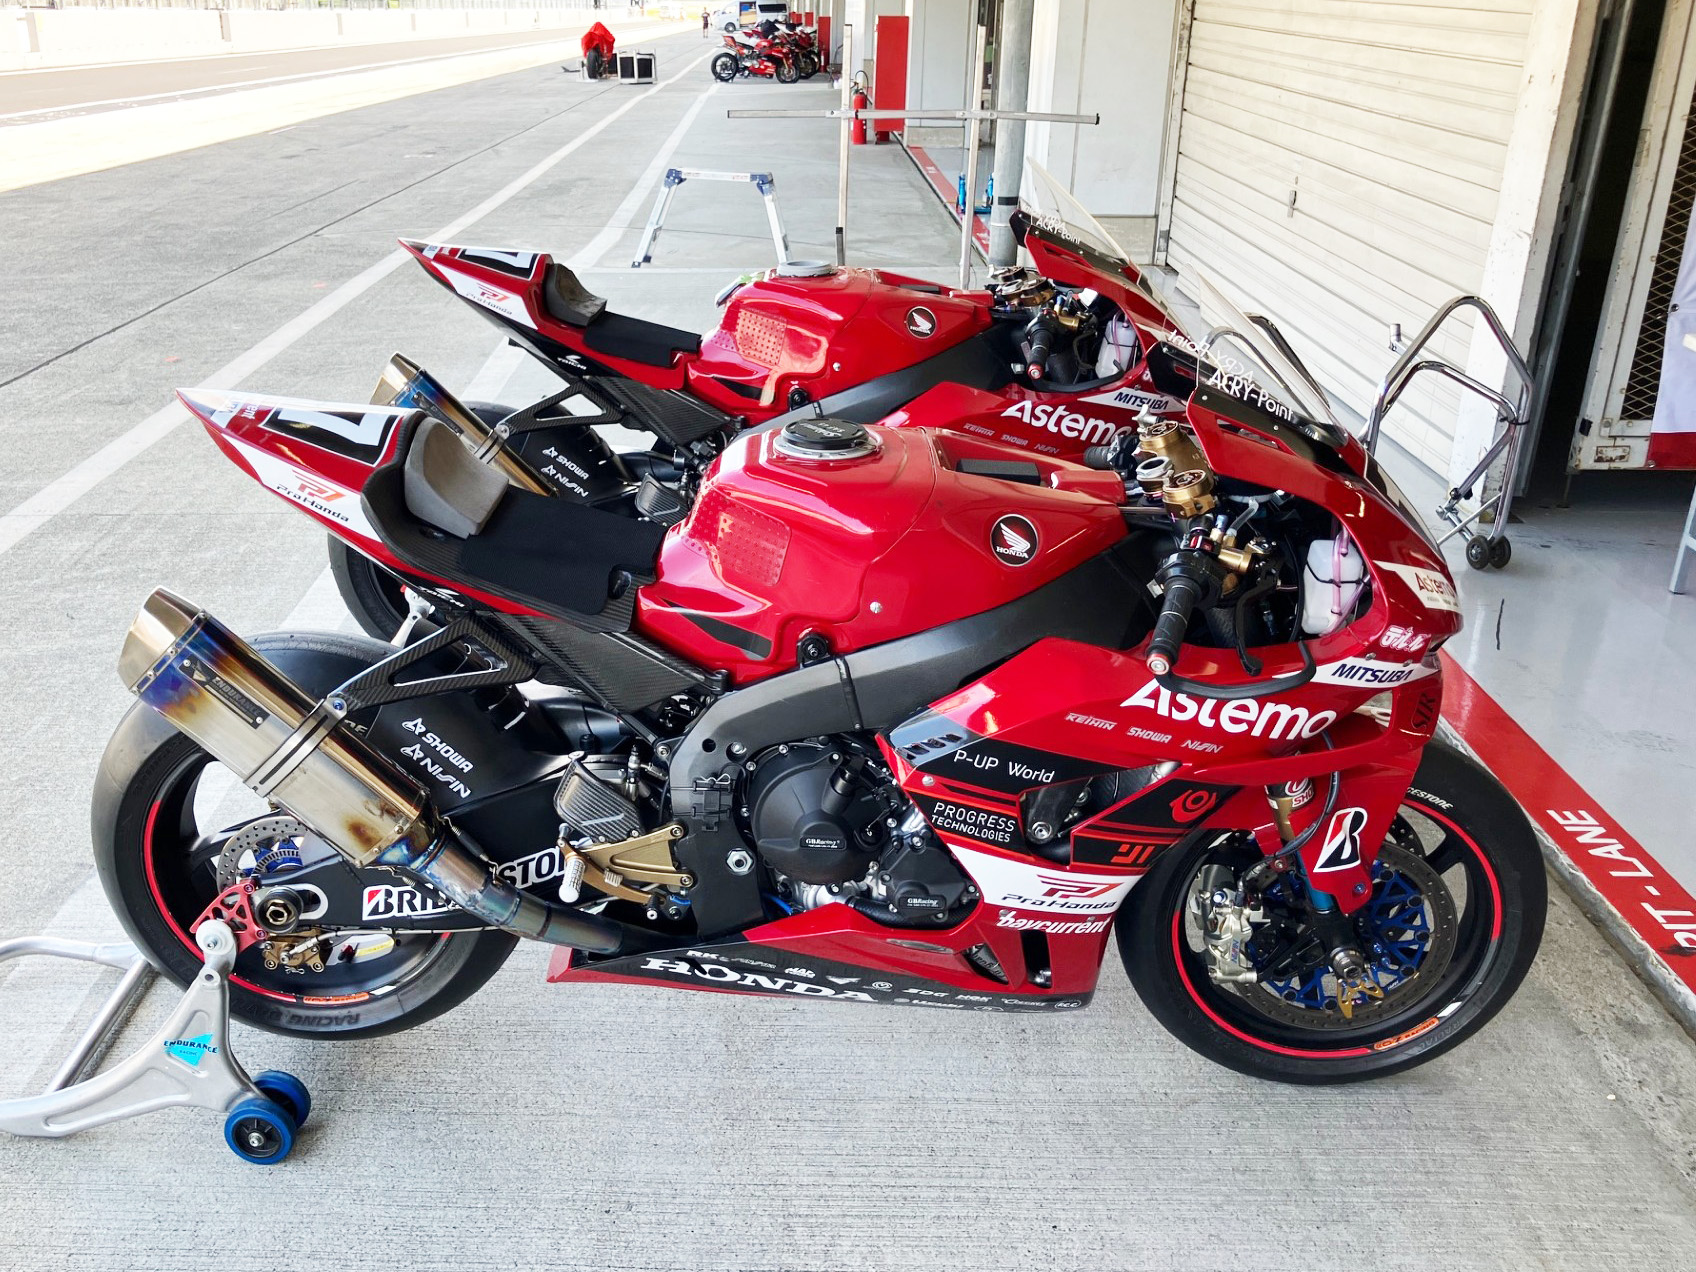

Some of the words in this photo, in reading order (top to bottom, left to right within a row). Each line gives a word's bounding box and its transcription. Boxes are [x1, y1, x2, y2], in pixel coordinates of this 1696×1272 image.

[1113, 391, 1170, 411] MITSUBA
[556, 454, 590, 481] SHOWA
[996, 546, 1029, 559] HONDA
[1331, 663, 1414, 684] MITSUBA
[1065, 712, 1118, 731] KEIHIN
[1120, 678, 1338, 741] Astemo
[1126, 725, 1172, 745] SHOWA
[421, 732, 474, 774] SHOWA
[953, 749, 999, 771] P-UP
[1008, 761, 1056, 783] World
[931, 814, 1012, 844] TECHNOLOGIES
[933, 801, 1016, 833] PROGRESS
[1546, 809, 1655, 878] LANE
[996, 909, 1112, 934] baycurrent
[641, 957, 879, 1002] HONDA
[163, 1039, 218, 1054] ENDURANCE
